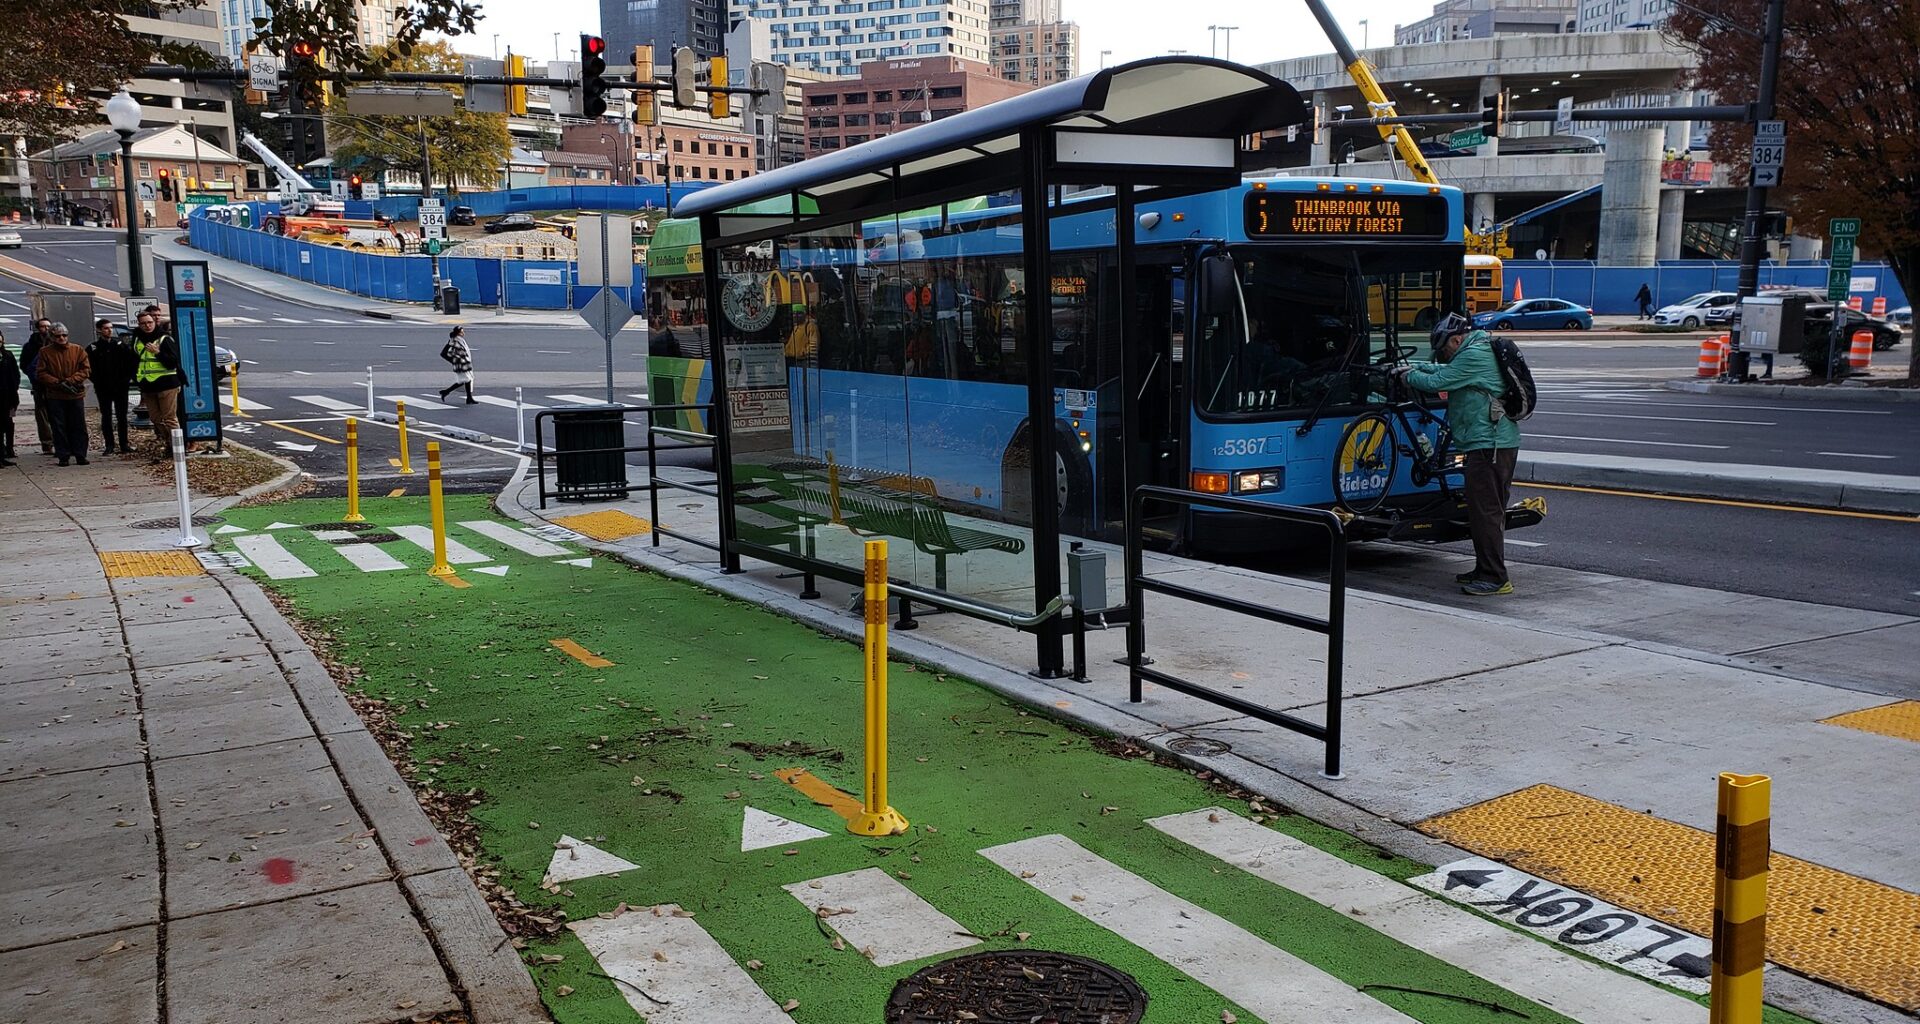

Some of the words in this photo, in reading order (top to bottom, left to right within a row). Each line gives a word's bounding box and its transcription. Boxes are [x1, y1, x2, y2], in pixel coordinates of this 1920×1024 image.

[252, 78, 276, 86] SIGNAL
[1761, 124, 1781, 132] WEST
[1452, 135, 1470, 148] Second
[1754, 147, 1782, 164] 384
[1296, 200, 1372, 215] TWINBROOK
[1376, 201, 1400, 216] VIA
[422, 214, 444, 225] 384
[1292, 217, 1351, 232] VICTORY
[1356, 218, 1404, 232] FOREST
[1835, 222, 1856, 232] END
[1070, 276, 1085, 285] VIA
[1060, 286, 1086, 294] FOREST
[732, 314, 772, 330] MARYLAND
[732, 394, 744, 402] NO
[746, 392, 787, 400] SMOKING
[1238, 389, 1276, 407] 1077
[733, 420, 746, 428] NO
[749, 417, 789, 426] SMOKING
[1468, 879, 1690, 964] LOOK
